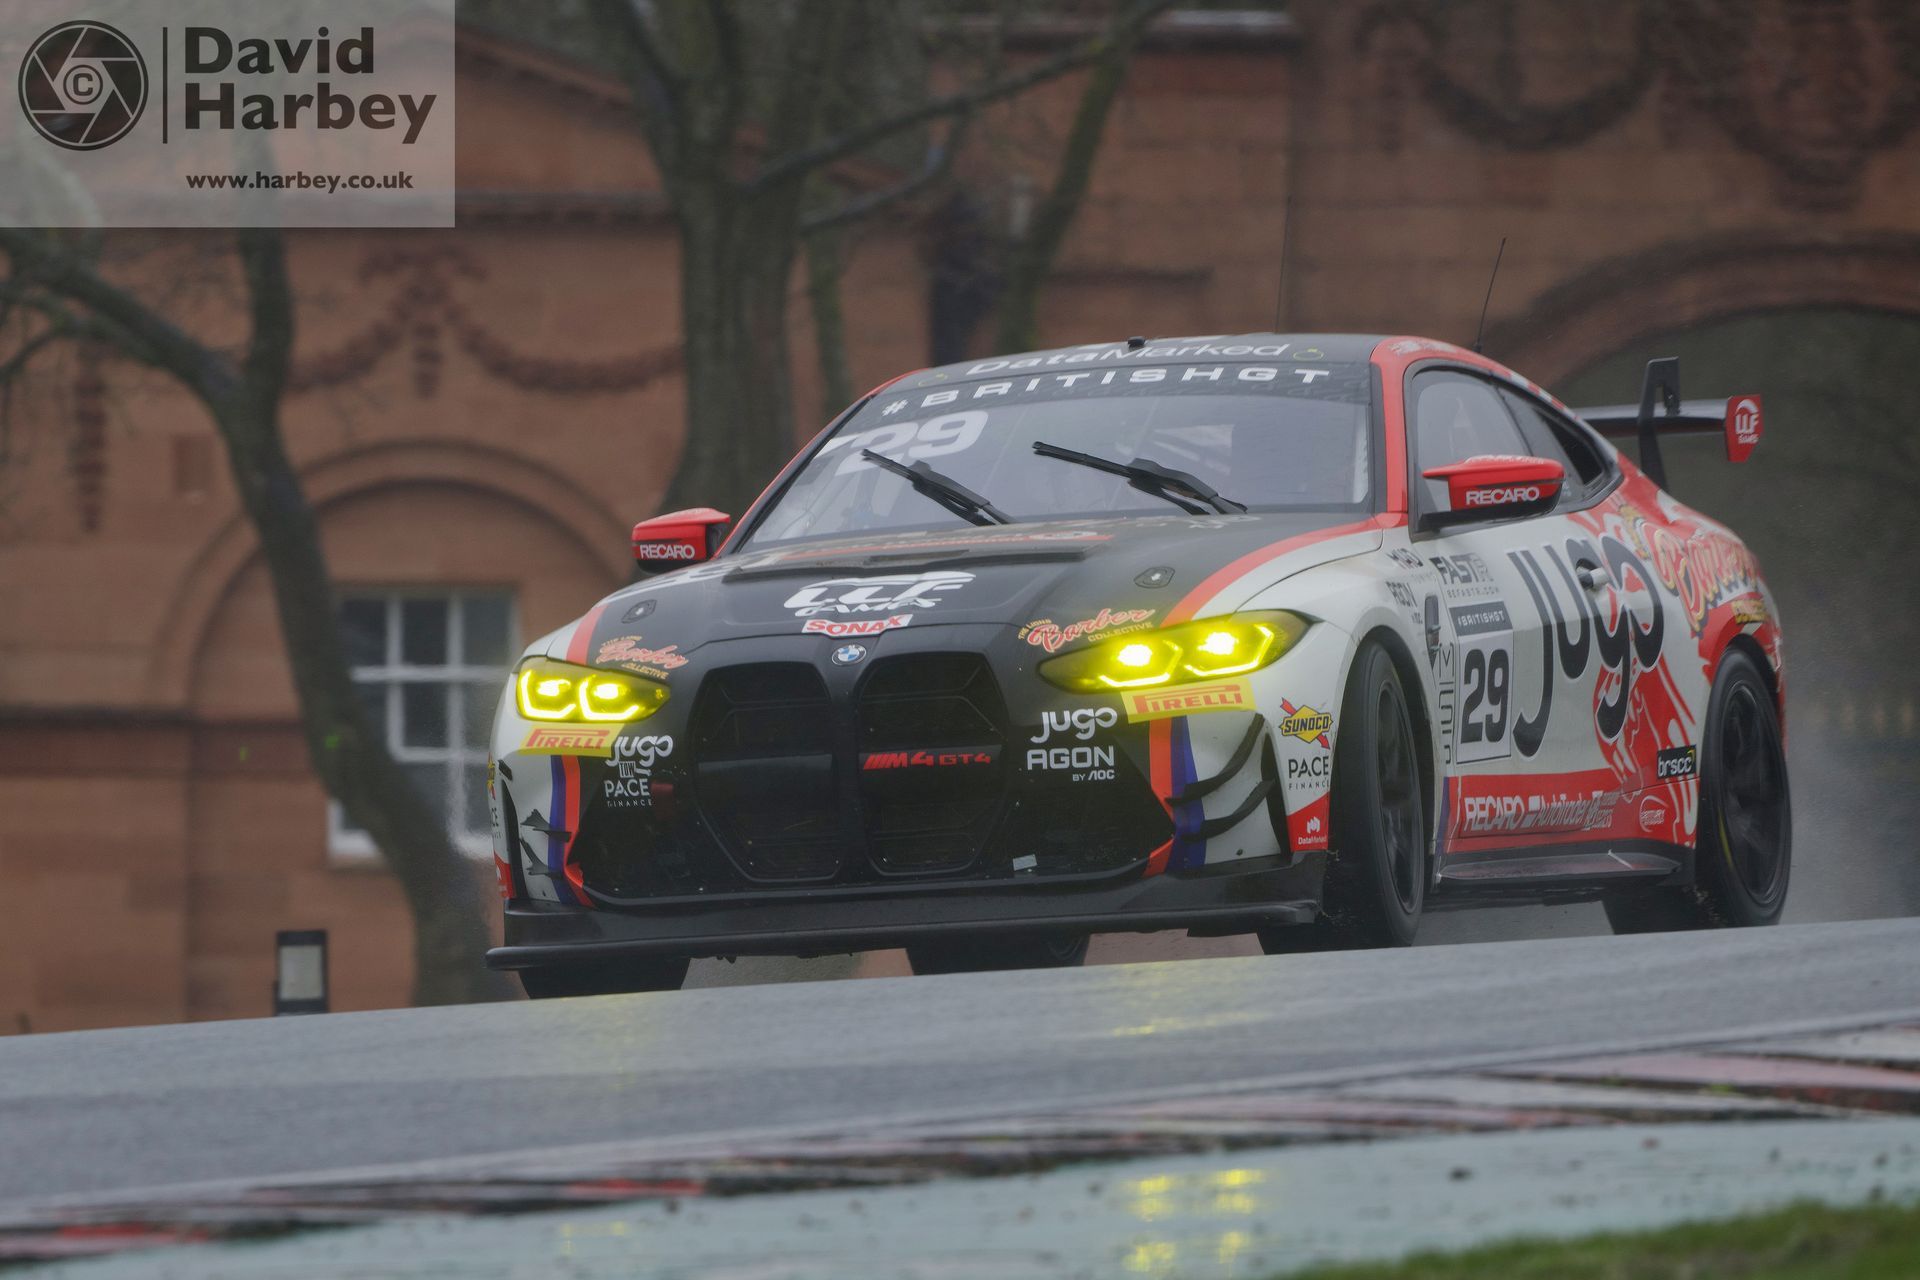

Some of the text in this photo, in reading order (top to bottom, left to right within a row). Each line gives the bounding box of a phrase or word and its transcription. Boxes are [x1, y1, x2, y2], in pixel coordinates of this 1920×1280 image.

[966, 343, 1290, 375] DataMarked
[835, 410, 989, 476] 29
[1466, 486, 1540, 506] RECARO
[640, 544, 696, 559] RECARO
[806, 616, 902, 635] SONAX
[1027, 608, 1155, 653] Barber
[1087, 621, 1154, 642] COLLECTIVE
[1133, 684, 1243, 714] PIRELLI
[1461, 649, 1509, 744] 29
[1030, 707, 1118, 744] jugo
[1284, 716, 1330, 734] SUNOCO
[525, 728, 611, 749] PIRELLI
[605, 735, 674, 767] jugo
[939, 752, 991, 767] GT4
[1026, 746, 1115, 770] AGON
[1288, 756, 1329, 779] PACE
[1658, 756, 1692, 777] brscc
[604, 778, 651, 798] PACE
[1072, 773, 1086, 782] BY
[1288, 779, 1331, 791] FINANCE
[1464, 795, 1525, 832] RECARO
